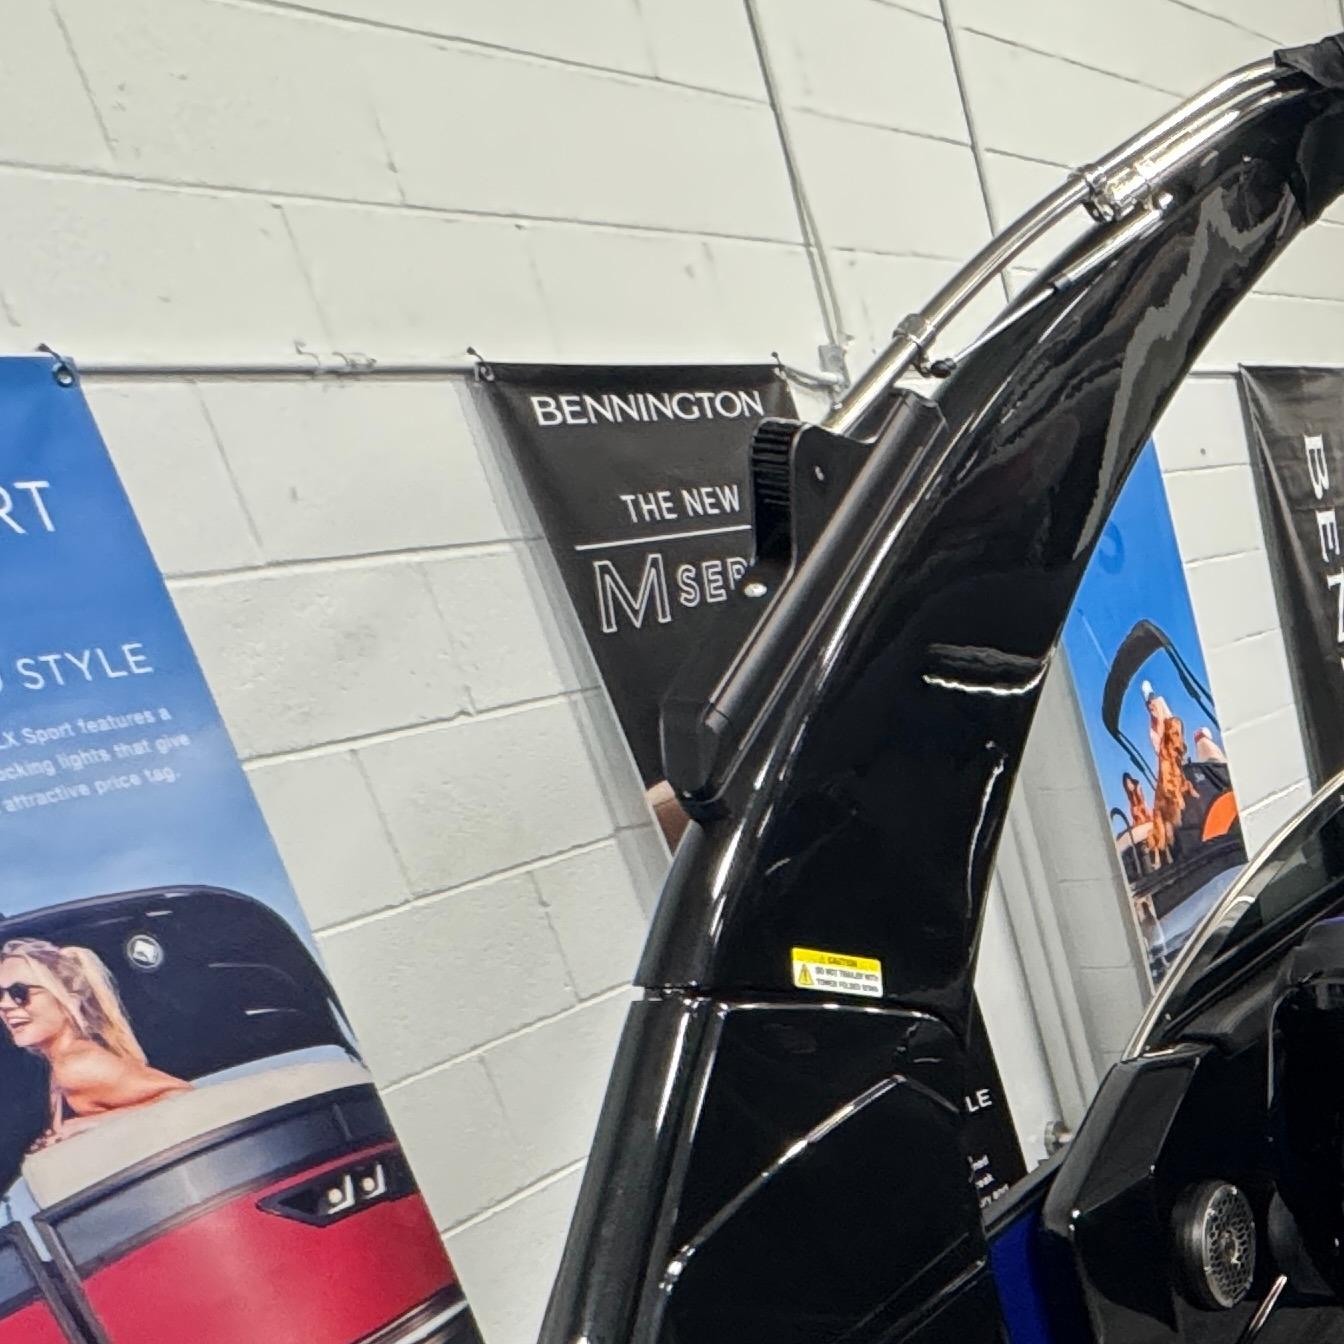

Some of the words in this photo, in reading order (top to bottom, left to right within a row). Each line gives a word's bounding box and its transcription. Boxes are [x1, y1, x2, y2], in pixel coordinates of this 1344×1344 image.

[530, 390, 765, 426] BENNINGTON
[620, 491, 678, 523] THE
[681, 484, 740, 517] NEW
[16, 643, 154, 690] STYLE
[22, 722, 76, 745] Sport
[77, 709, 156, 734] features
[158, 707, 172, 721] a
[56, 748, 112, 771] lights
[113, 739, 153, 759] that
[155, 733, 191, 755] give
[5, 784, 91, 812] attractive
[94, 774, 142, 795] price
[143, 766, 182, 784] tag.
[965, 1088, 992, 1112] LE
